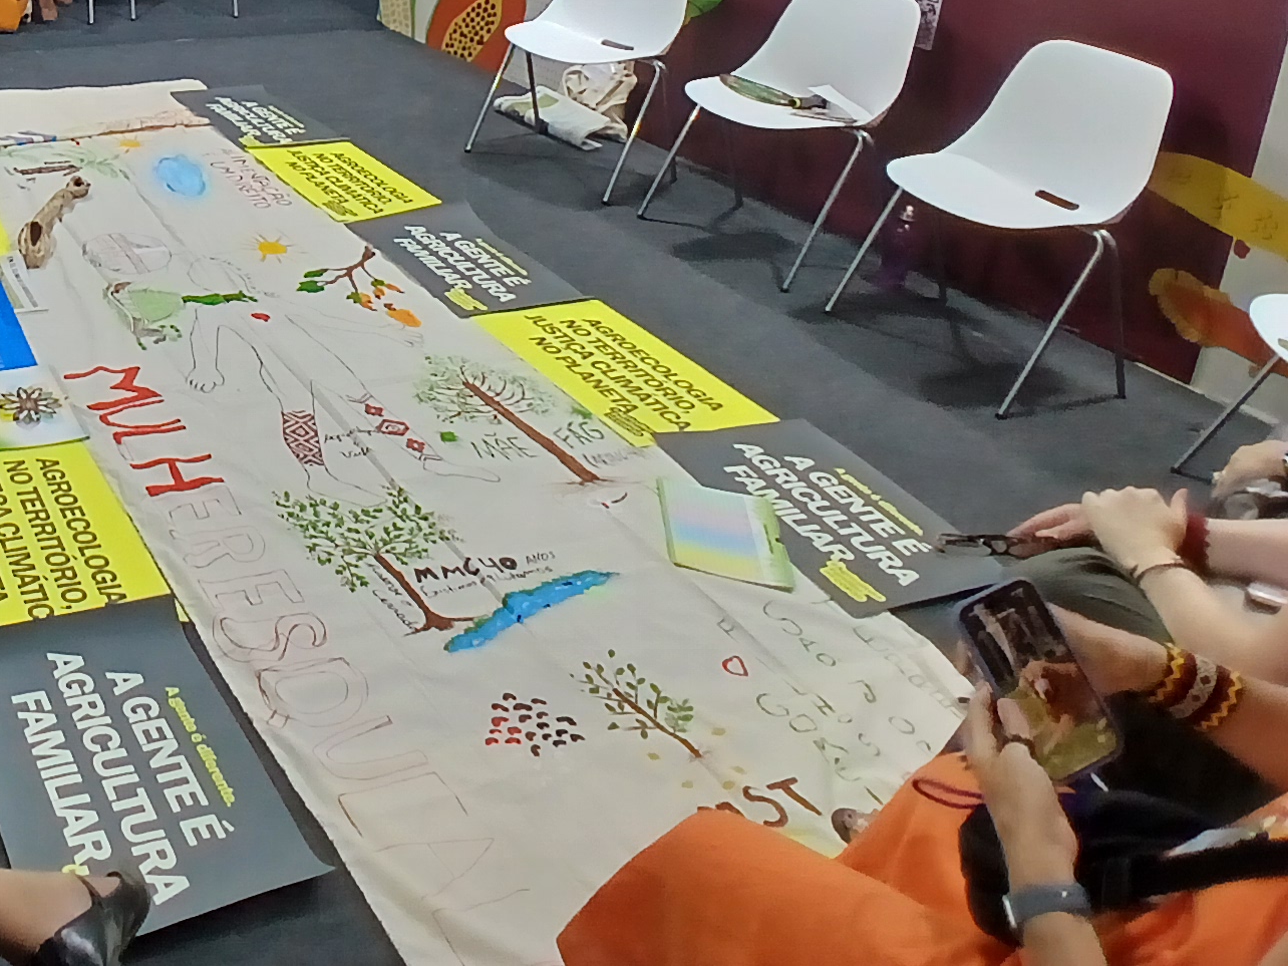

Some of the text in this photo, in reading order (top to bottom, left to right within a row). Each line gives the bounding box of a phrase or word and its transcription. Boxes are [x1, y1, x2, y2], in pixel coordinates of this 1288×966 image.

[285, 161, 349, 204] NO PLANETA
[313, 153, 334, 163] NO
[330, 153, 414, 204] AGROECOLOGIA
[393, 237, 473, 291] FAMILIAR
[403, 225, 516, 303] AGRICULTURA
[439, 232, 532, 287] A GENTE É
[525, 314, 595, 359] JUSTIÇA
[591, 359, 692, 432] CLIMÁTICA
[529, 336, 640, 416] NO PLANETA
[560, 319, 696, 414] NO TERRITÓRIO,
[582, 318, 724, 412] AGROECOLOGIA
[3, 459, 88, 610] NO TERRITÓRIO,
[36, 458, 128, 604] AGROECOLOGIA
[64, 366, 328, 664] MULHERES
[723, 465, 855, 562] FAMILIAR
[733, 443, 920, 587] AGRICULTURA
[784, 455, 933, 556] A GENTE É
[165, 687, 180, 698] A
[168, 697, 197, 732] gente
[191, 733, 207, 743] é
[11, 690, 112, 866] FAMILIAR
[47, 652, 190, 906] AGRICULTURA
[105, 671, 235, 847] A GENTE É
